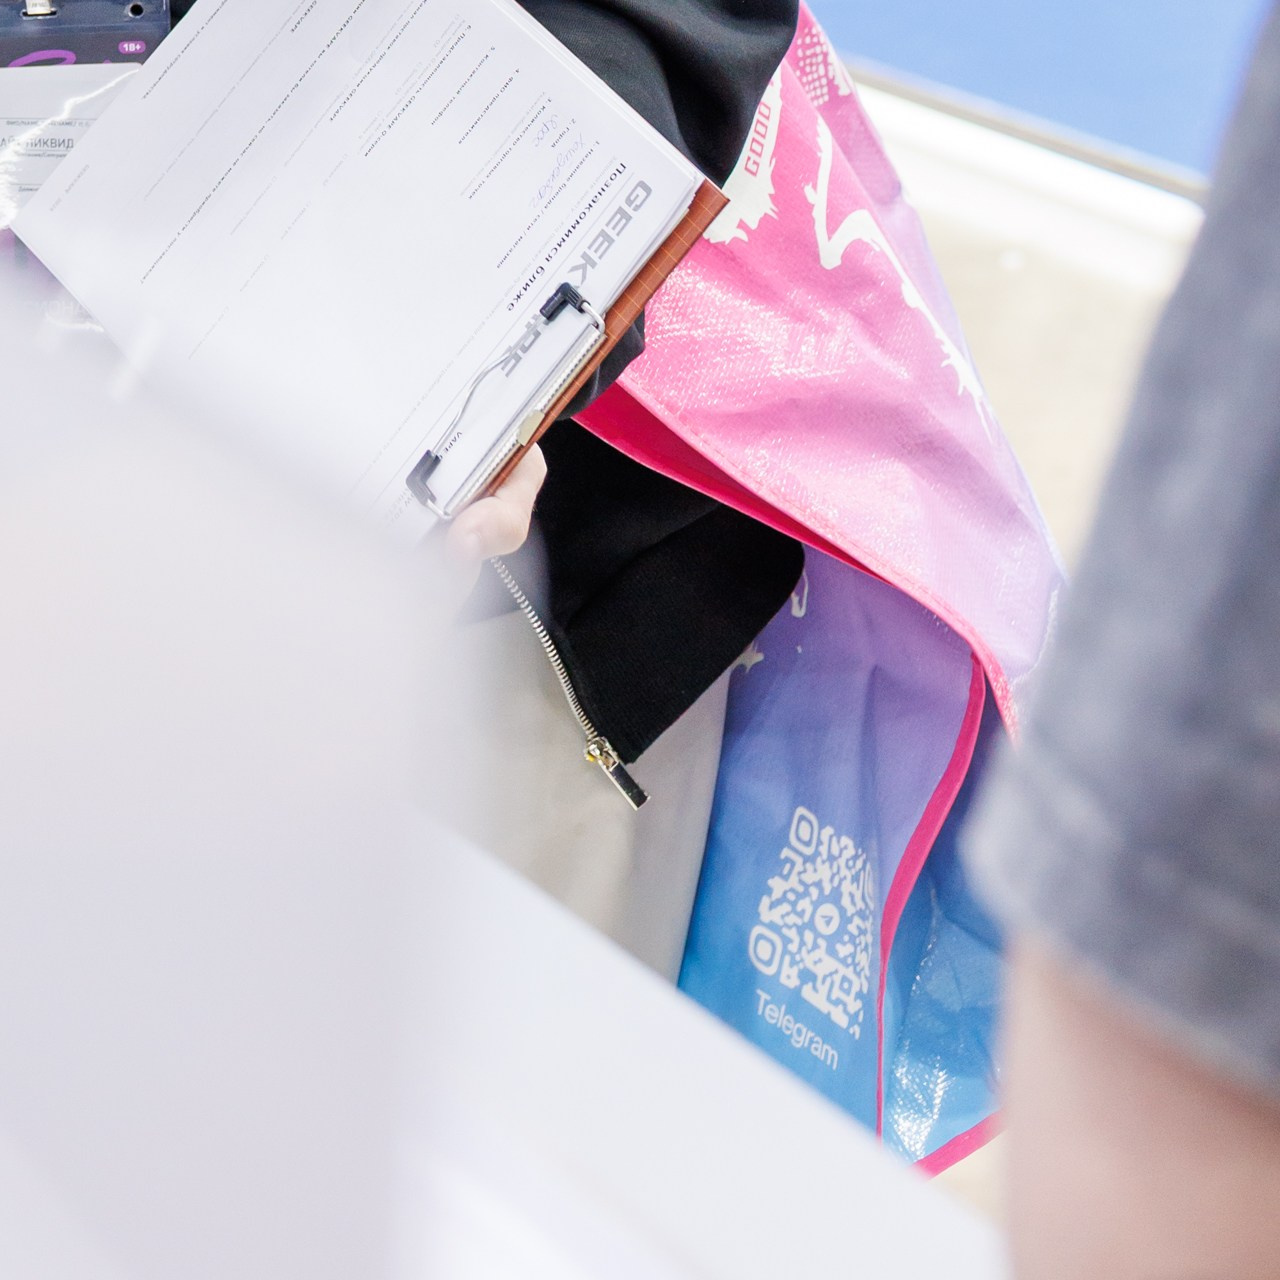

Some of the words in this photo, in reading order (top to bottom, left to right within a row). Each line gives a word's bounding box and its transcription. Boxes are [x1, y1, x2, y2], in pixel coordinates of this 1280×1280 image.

[289, 0, 318, 34] GEEKVAPE
[324, 13, 354, 49] GEEKVAPE
[122, 43, 142, 53] 18+
[328, 87, 357, 122] GEEKVAPE
[385, 94, 416, 130] GEEKVAPE
[564, 147, 594, 182] Название
[543, 161, 627, 263] Познакомимся
[504, 264, 546, 313] ближе
[442, 430, 462, 454] VAPE
[755, 988, 840, 1071] Telegram
